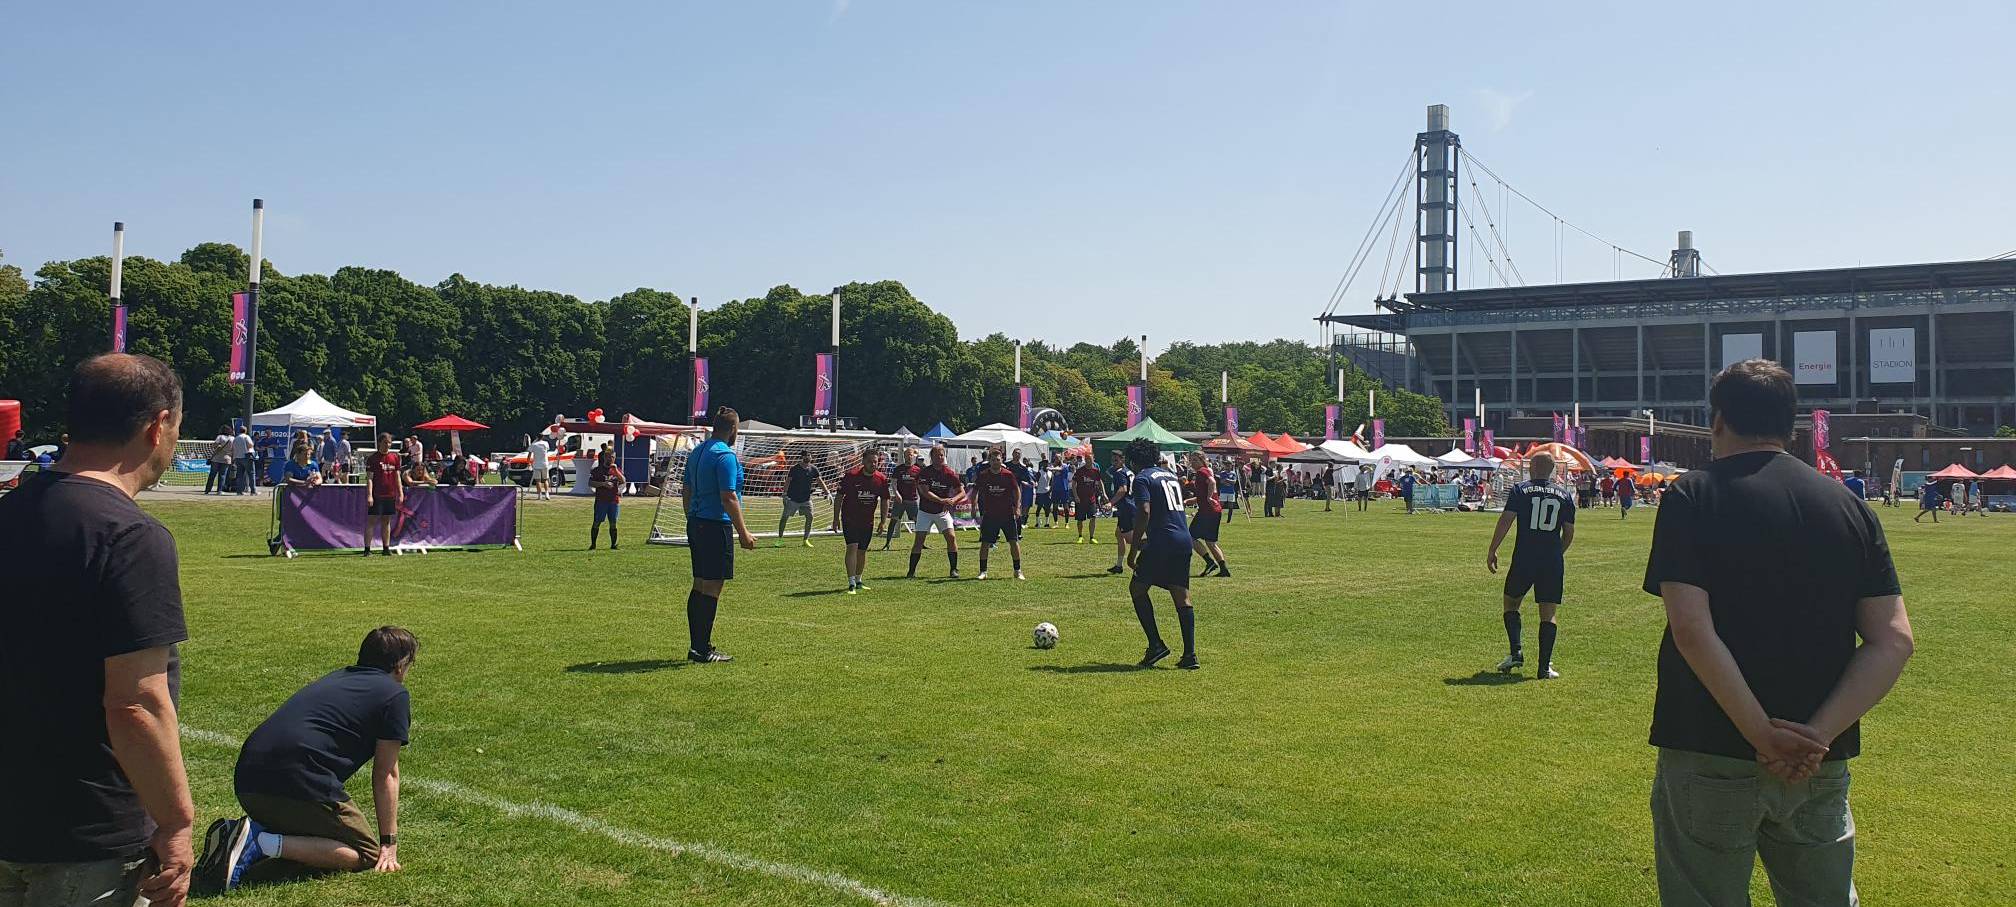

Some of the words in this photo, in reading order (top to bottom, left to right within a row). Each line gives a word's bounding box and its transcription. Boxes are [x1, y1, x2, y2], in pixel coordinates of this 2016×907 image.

[1799, 362, 1832, 371] Energie
[1872, 360, 1913, 369] STADION
[1160, 479, 1184, 511] 10
[1529, 496, 1561, 532] 10
